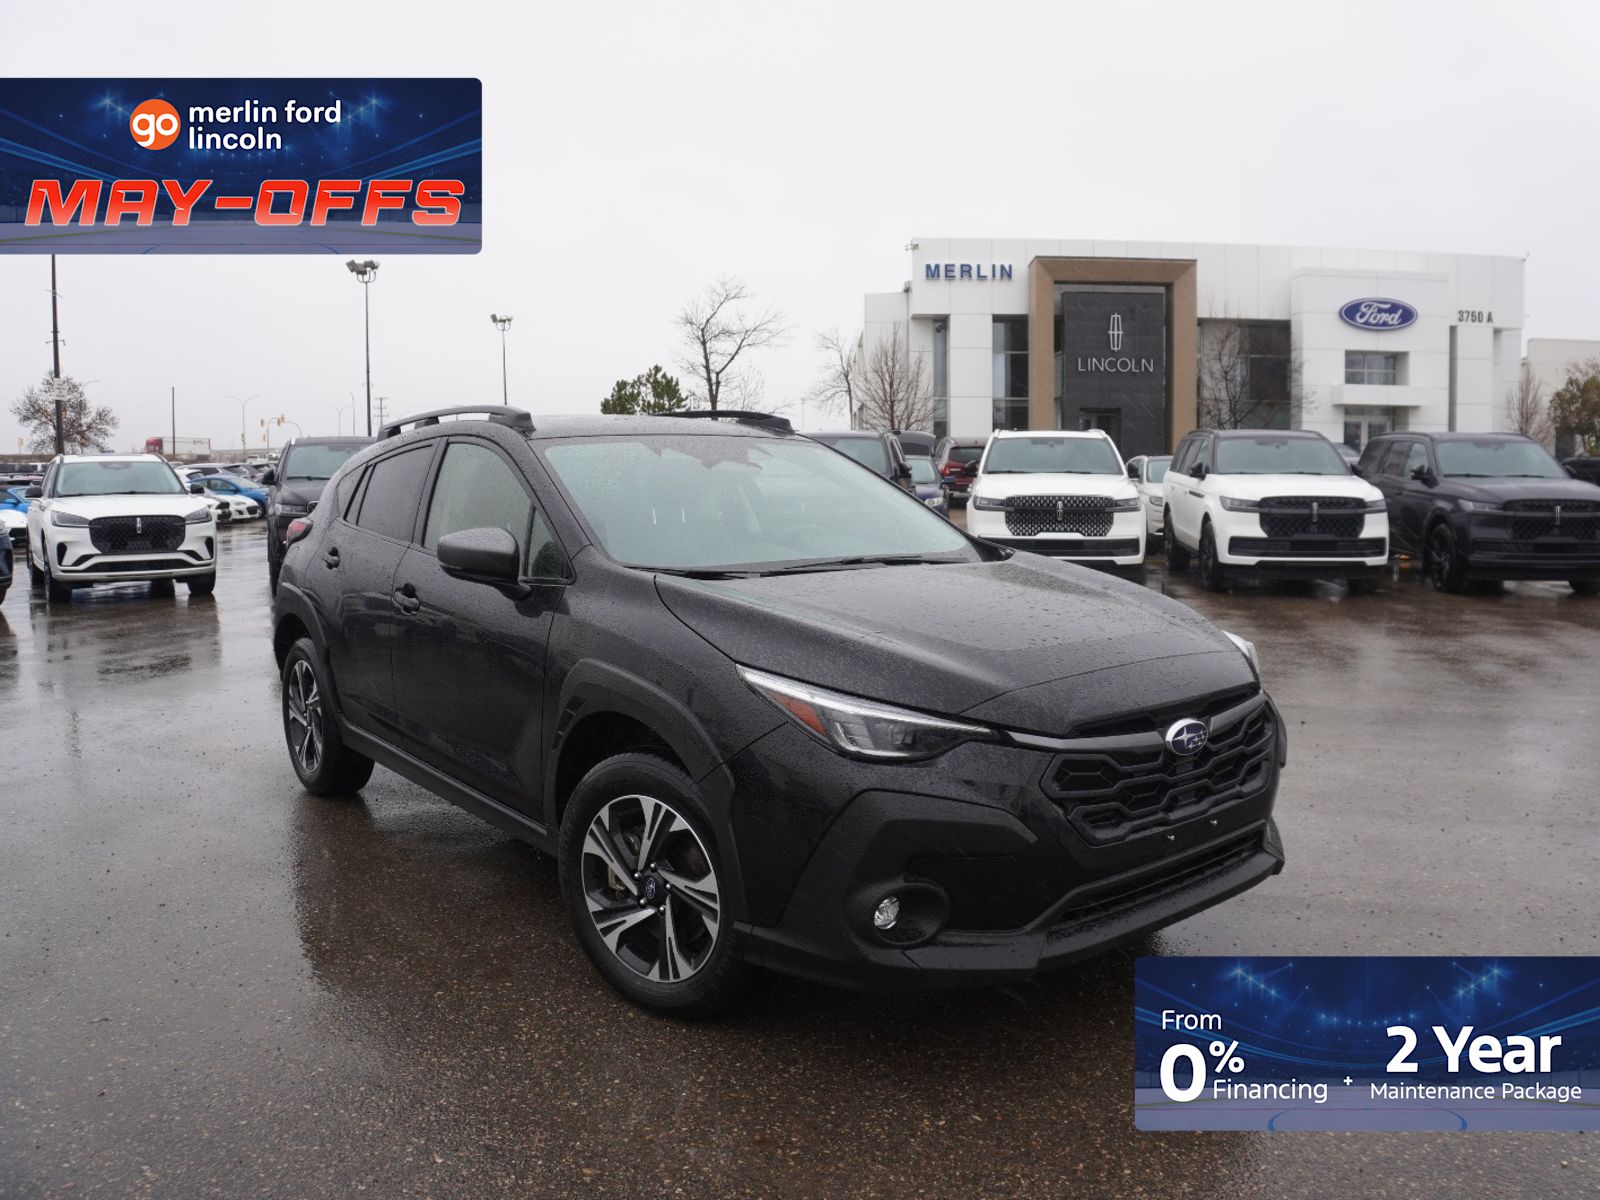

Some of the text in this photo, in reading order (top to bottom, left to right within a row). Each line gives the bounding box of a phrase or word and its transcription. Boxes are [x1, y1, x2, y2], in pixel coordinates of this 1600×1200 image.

[925, 263, 1013, 281] MERLIN
[1355, 301, 1403, 326] Ford
[1457, 310, 1493, 324] 3750 A
[1077, 357, 1154, 373] LINCOLN
